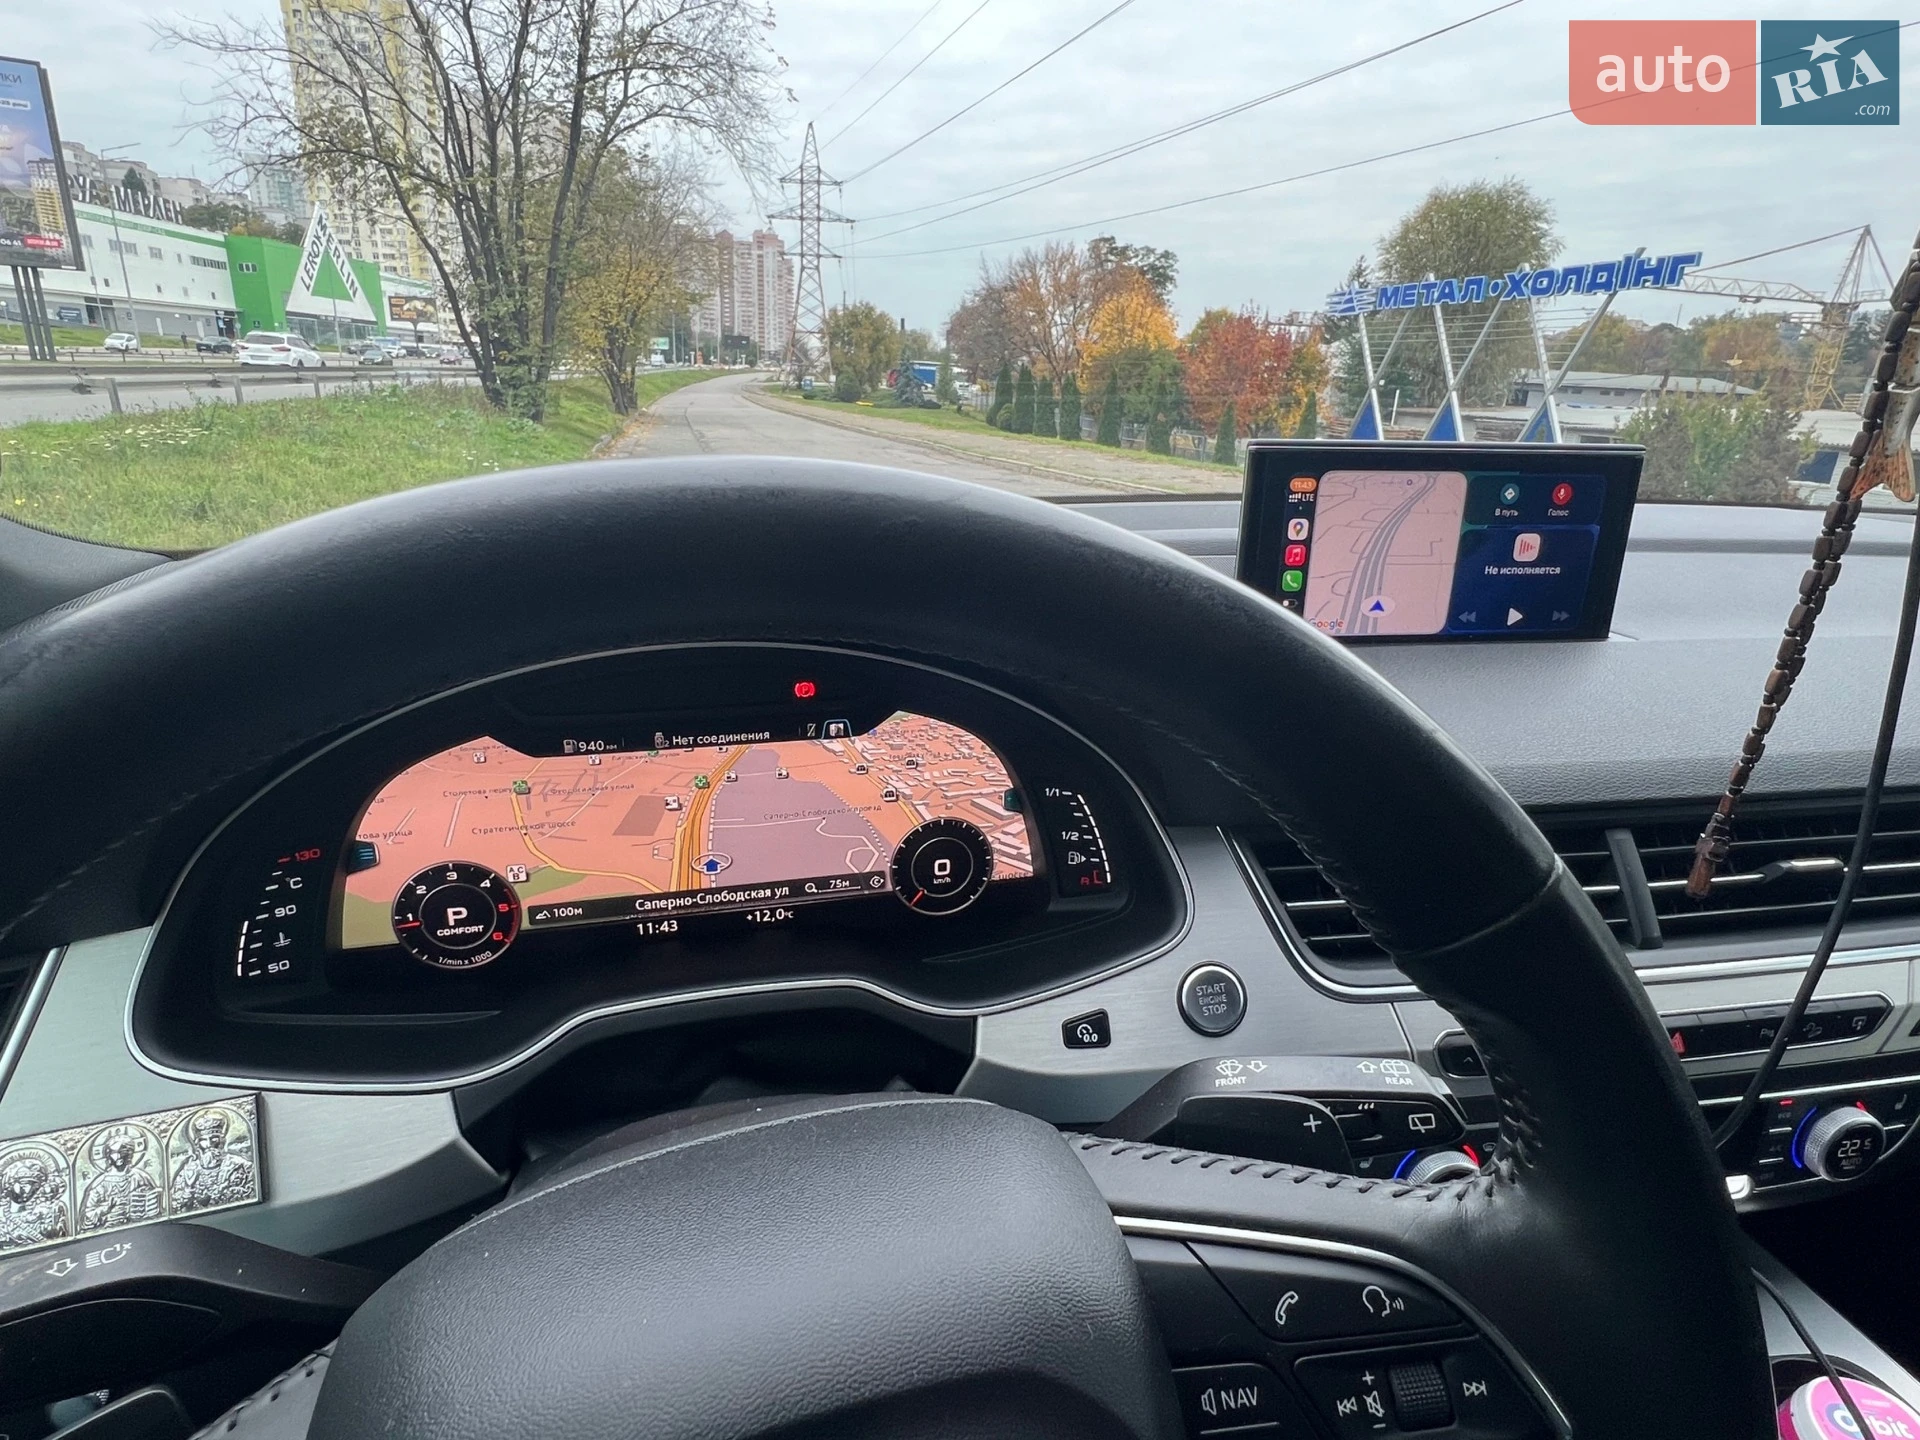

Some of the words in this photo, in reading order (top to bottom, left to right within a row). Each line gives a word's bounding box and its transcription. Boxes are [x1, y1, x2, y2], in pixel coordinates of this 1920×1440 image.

[317, 213, 358, 299] MERLIN
[1375, 275, 1485, 311] МЕТАЛ
[1500, 252, 1703, 301] ХОЛДІНГ
[1302, 493, 1315, 501] LTE
[1547, 508, 1570, 516] Голос
[1484, 565, 1499, 575] Не
[1500, 566, 1561, 575] исполняется
[672, 735, 695, 746] Нет
[696, 731, 770, 745] соединения
[579, 740, 605, 752] 940
[1045, 787, 1060, 797] 1/1
[1061, 831, 1079, 841] 1/2
[294, 848, 321, 863] 130
[934, 858, 951, 875] 0
[446, 871, 458, 881] 3
[416, 885, 427, 894] 2
[480, 879, 491, 888] 4
[635, 887, 772, 912] Саперно-Слободская
[774, 885, 790, 899] ул
[274, 904, 297, 917] 90
[498, 903, 509, 912] 5
[446, 906, 468, 926] P
[436, 924, 485, 937] COMFORT
[636, 919, 679, 936] 11:43
[438, 956, 463, 966] 1/min
[470, 950, 493, 964] 1000
[268, 960, 290, 974] 50
[1195, 982, 1226, 996] START
[1198, 993, 1228, 1006] ENGINE
[1202, 1004, 1227, 1017] STOP
[1215, 1076, 1247, 1088] FRONT
[1384, 1076, 1413, 1086] REAR
[1220, 1386, 1258, 1410] NAV
